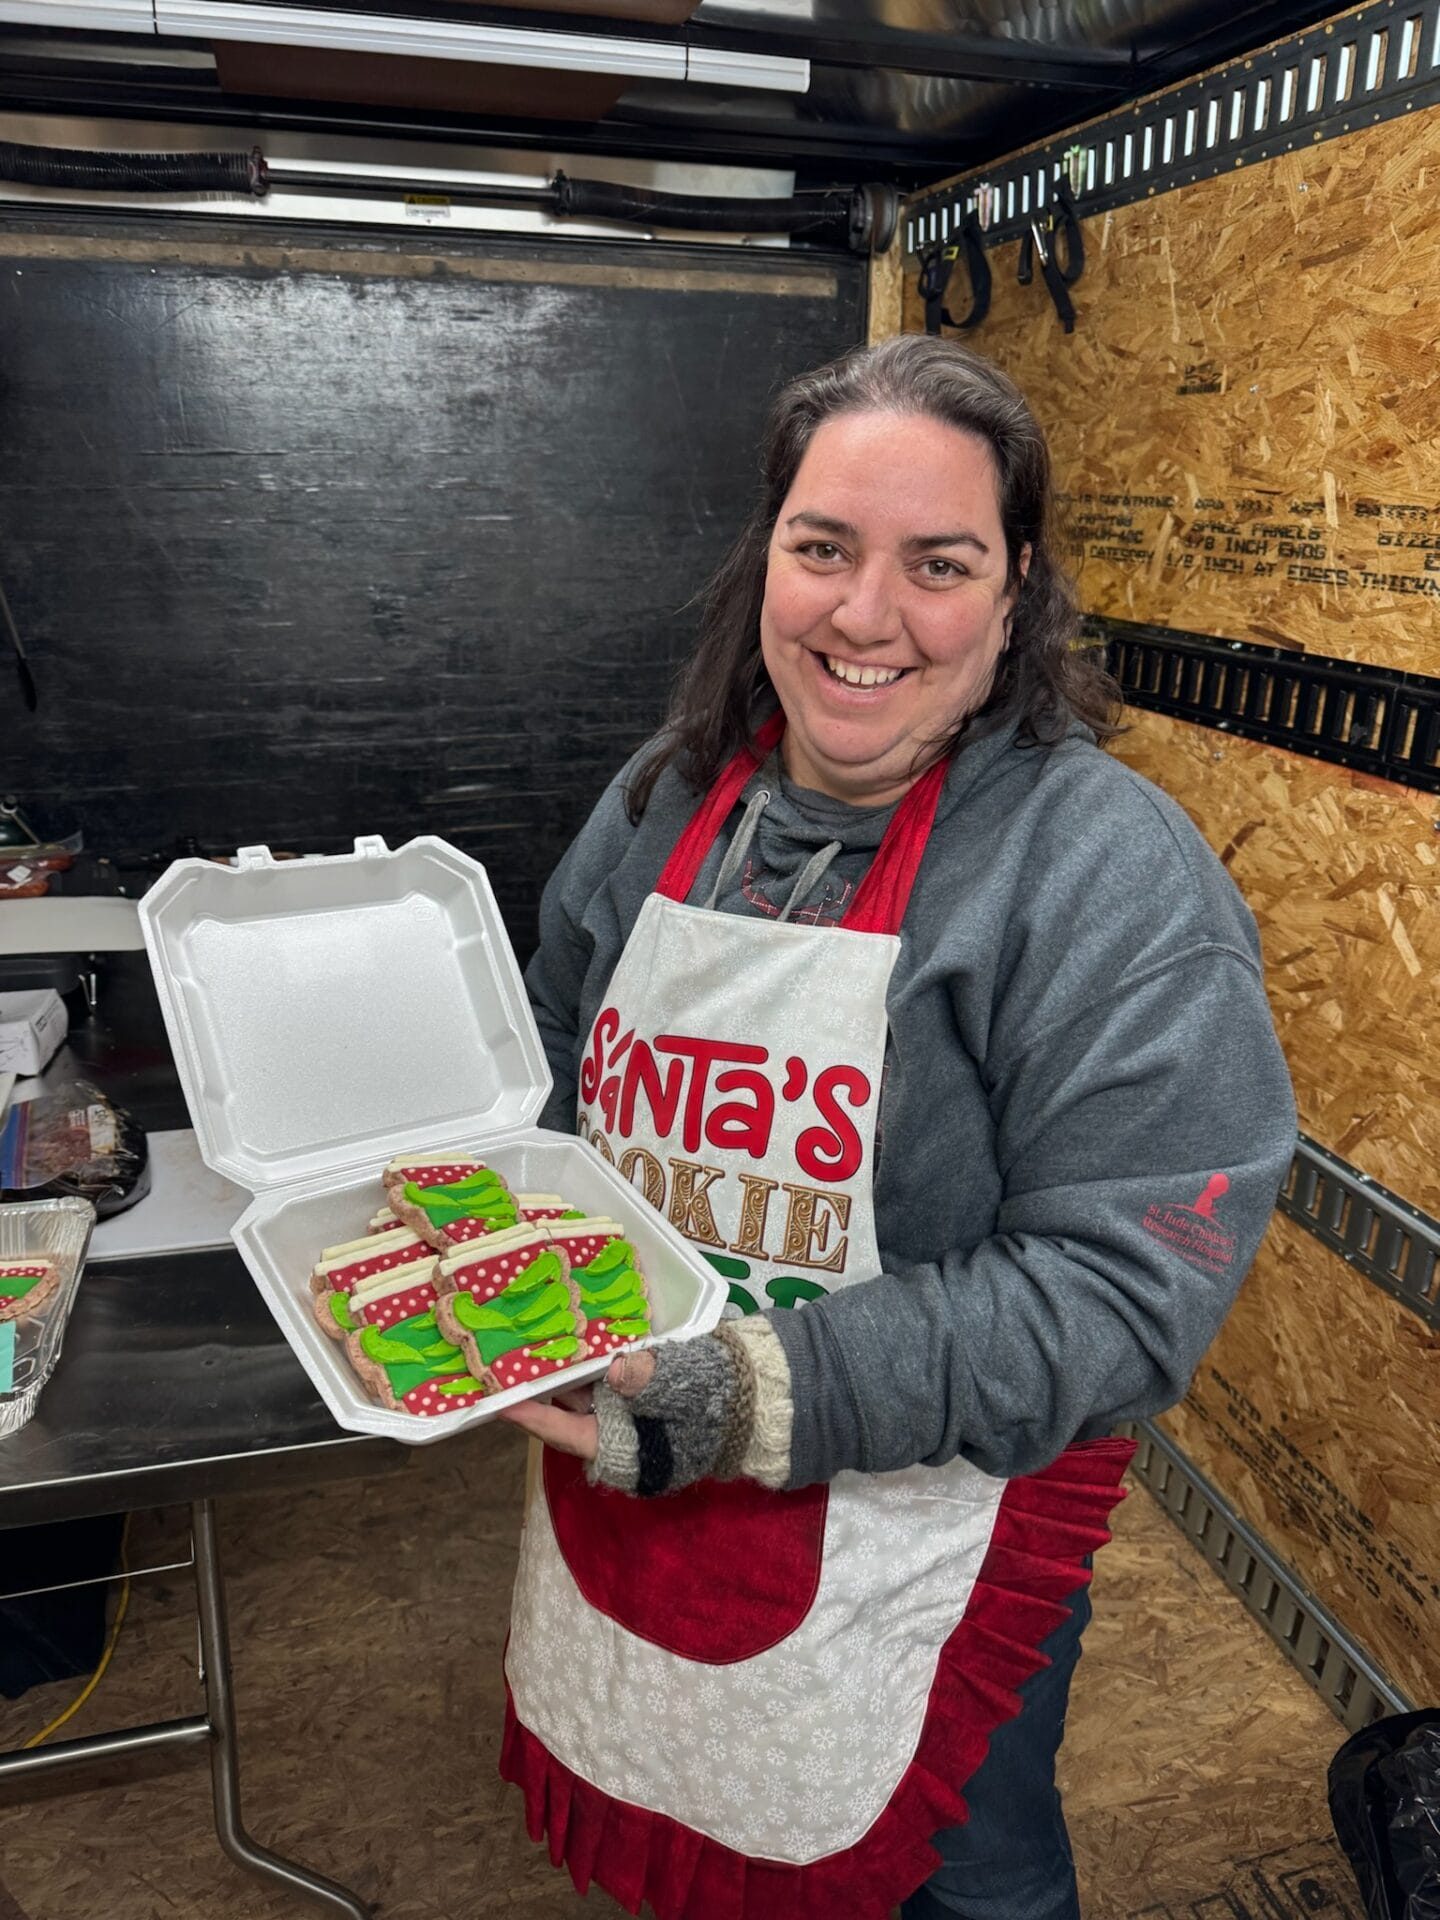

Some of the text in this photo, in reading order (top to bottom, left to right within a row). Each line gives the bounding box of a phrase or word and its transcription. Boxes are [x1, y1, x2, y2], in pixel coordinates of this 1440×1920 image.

[1225, 537, 1269, 556] INCH
[1277, 540, 1327, 561] ENDS
[1203, 555, 1245, 575] INCH
[1253, 559, 1278, 577] AT
[1142, 1215, 1191, 1247] Research
[1162, 1210, 1190, 1231] Jude
